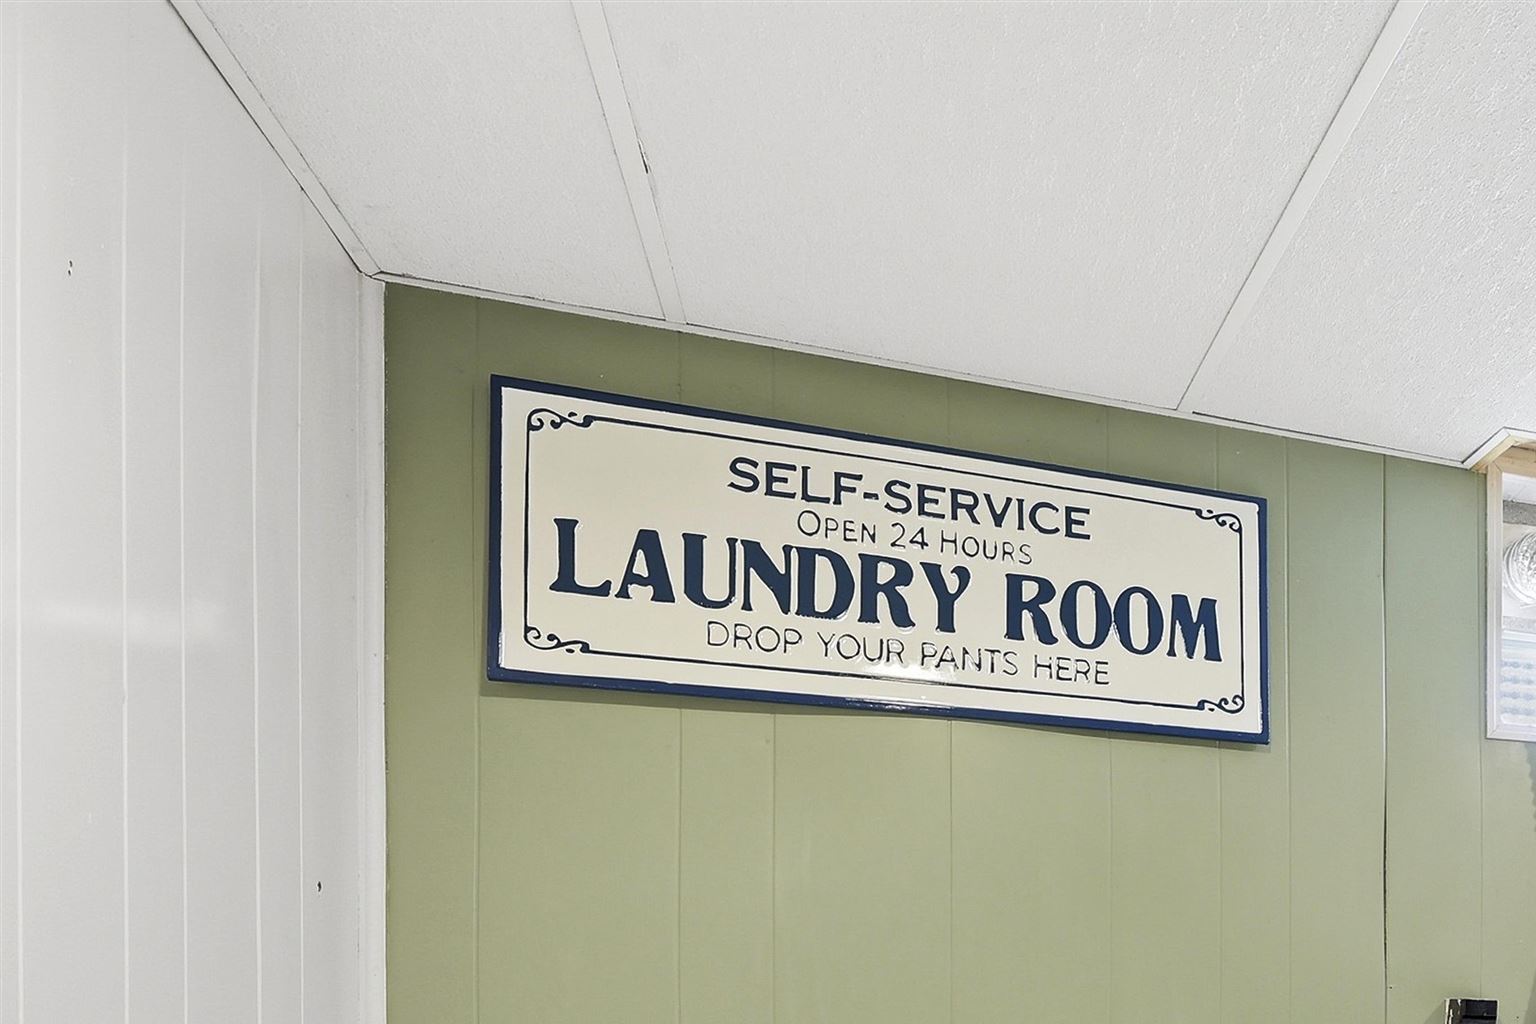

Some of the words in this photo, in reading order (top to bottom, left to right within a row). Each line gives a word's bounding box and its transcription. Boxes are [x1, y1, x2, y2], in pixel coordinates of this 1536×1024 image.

[726, 456, 1092, 541] SELF-SERVICE
[890, 522, 930, 551] 24
[940, 529, 1034, 566] HOURS
[548, 517, 972, 634] LAUNDRY
[1003, 572, 1224, 663] ROOM
[706, 620, 803, 655] DROP
[816, 631, 906, 665] YOUR
[920, 641, 1019, 677] PANTS
[1034, 655, 1111, 686] HERE
